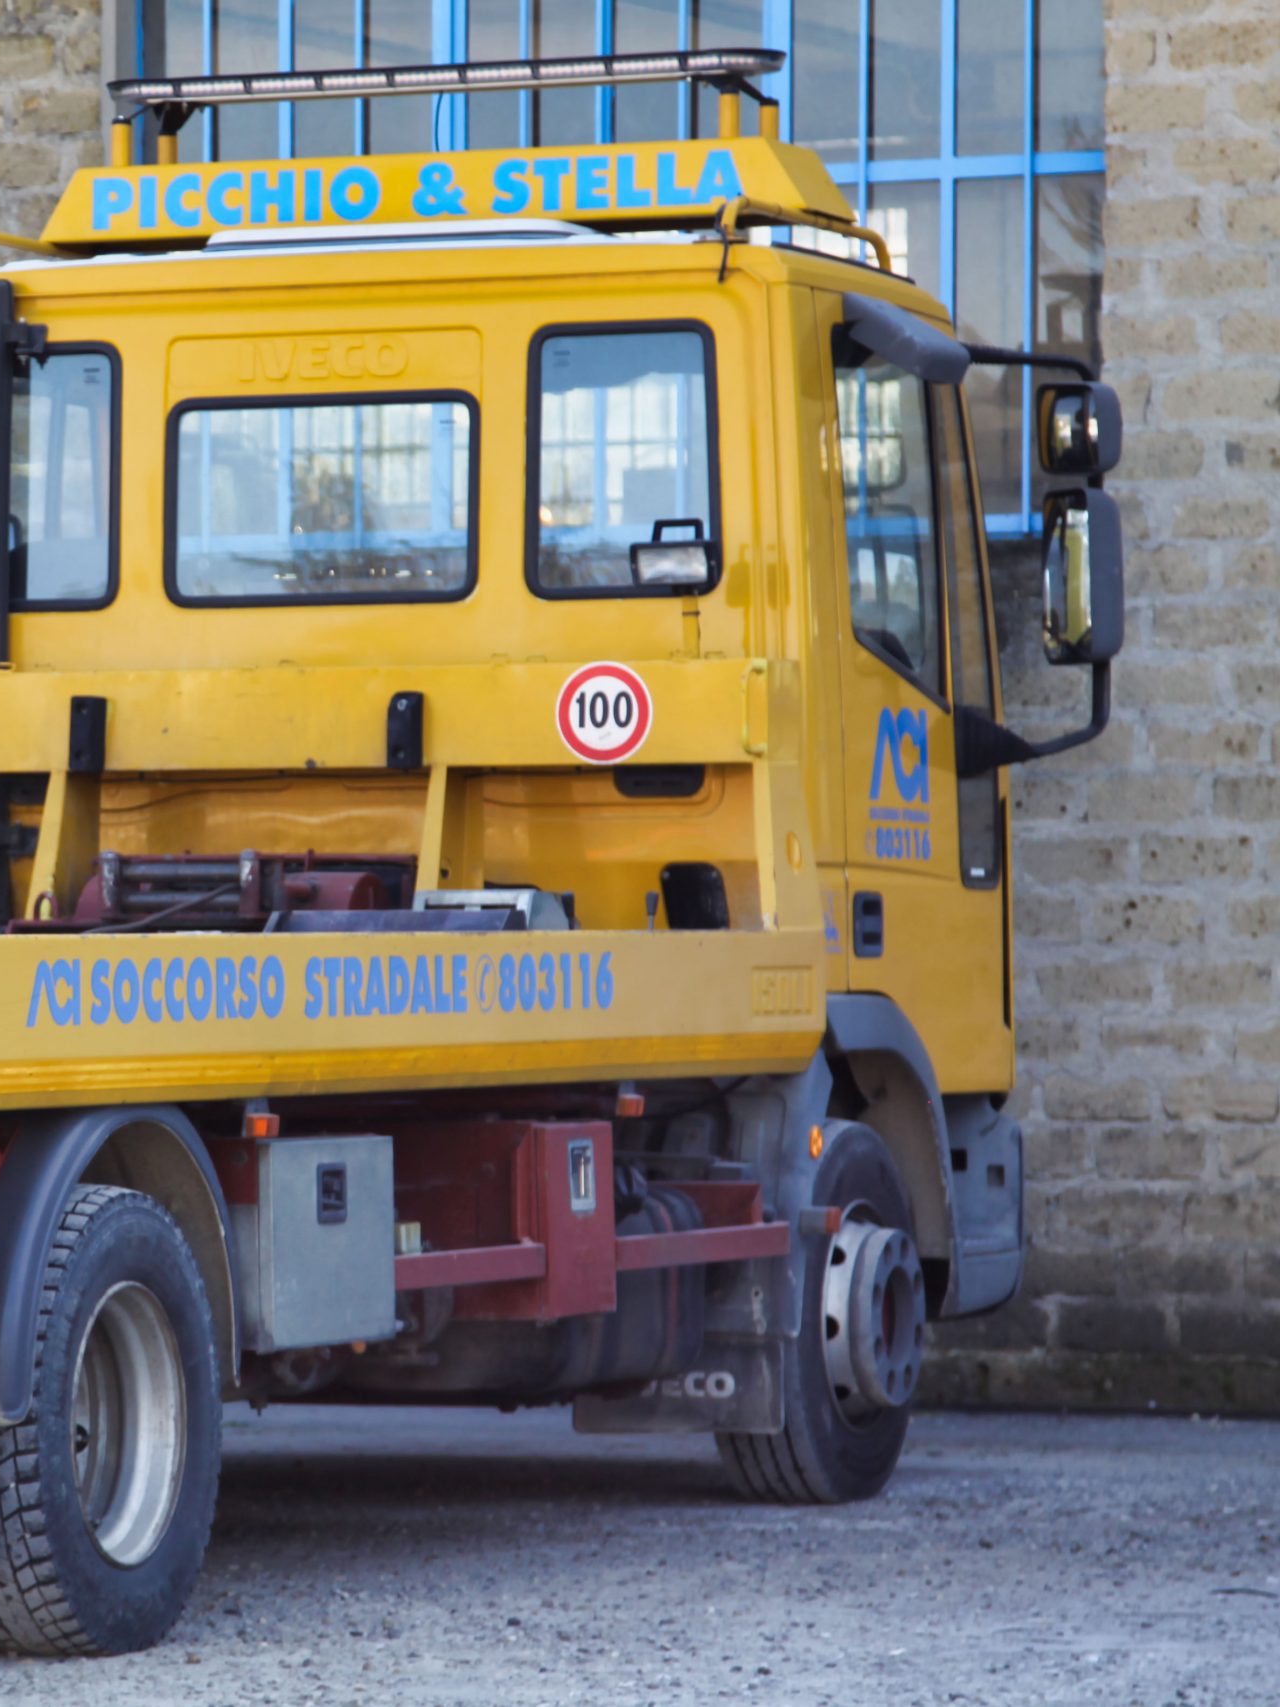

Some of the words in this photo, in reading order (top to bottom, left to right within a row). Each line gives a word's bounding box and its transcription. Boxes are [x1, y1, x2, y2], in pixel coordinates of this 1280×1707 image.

[92, 166, 381, 231] PICCHIO
[412, 162, 468, 217] &
[491, 149, 744, 214] STELLA
[239, 334, 410, 382] IVECO
[576, 691, 633, 729] 100
[868, 707, 929, 804] ACI
[876, 826, 931, 861] 803116
[26, 958, 80, 1027] ACI
[90, 955, 286, 1025] SOCCORSO
[304, 954, 468, 1019] STRADALE
[498, 951, 614, 1013] 803116
